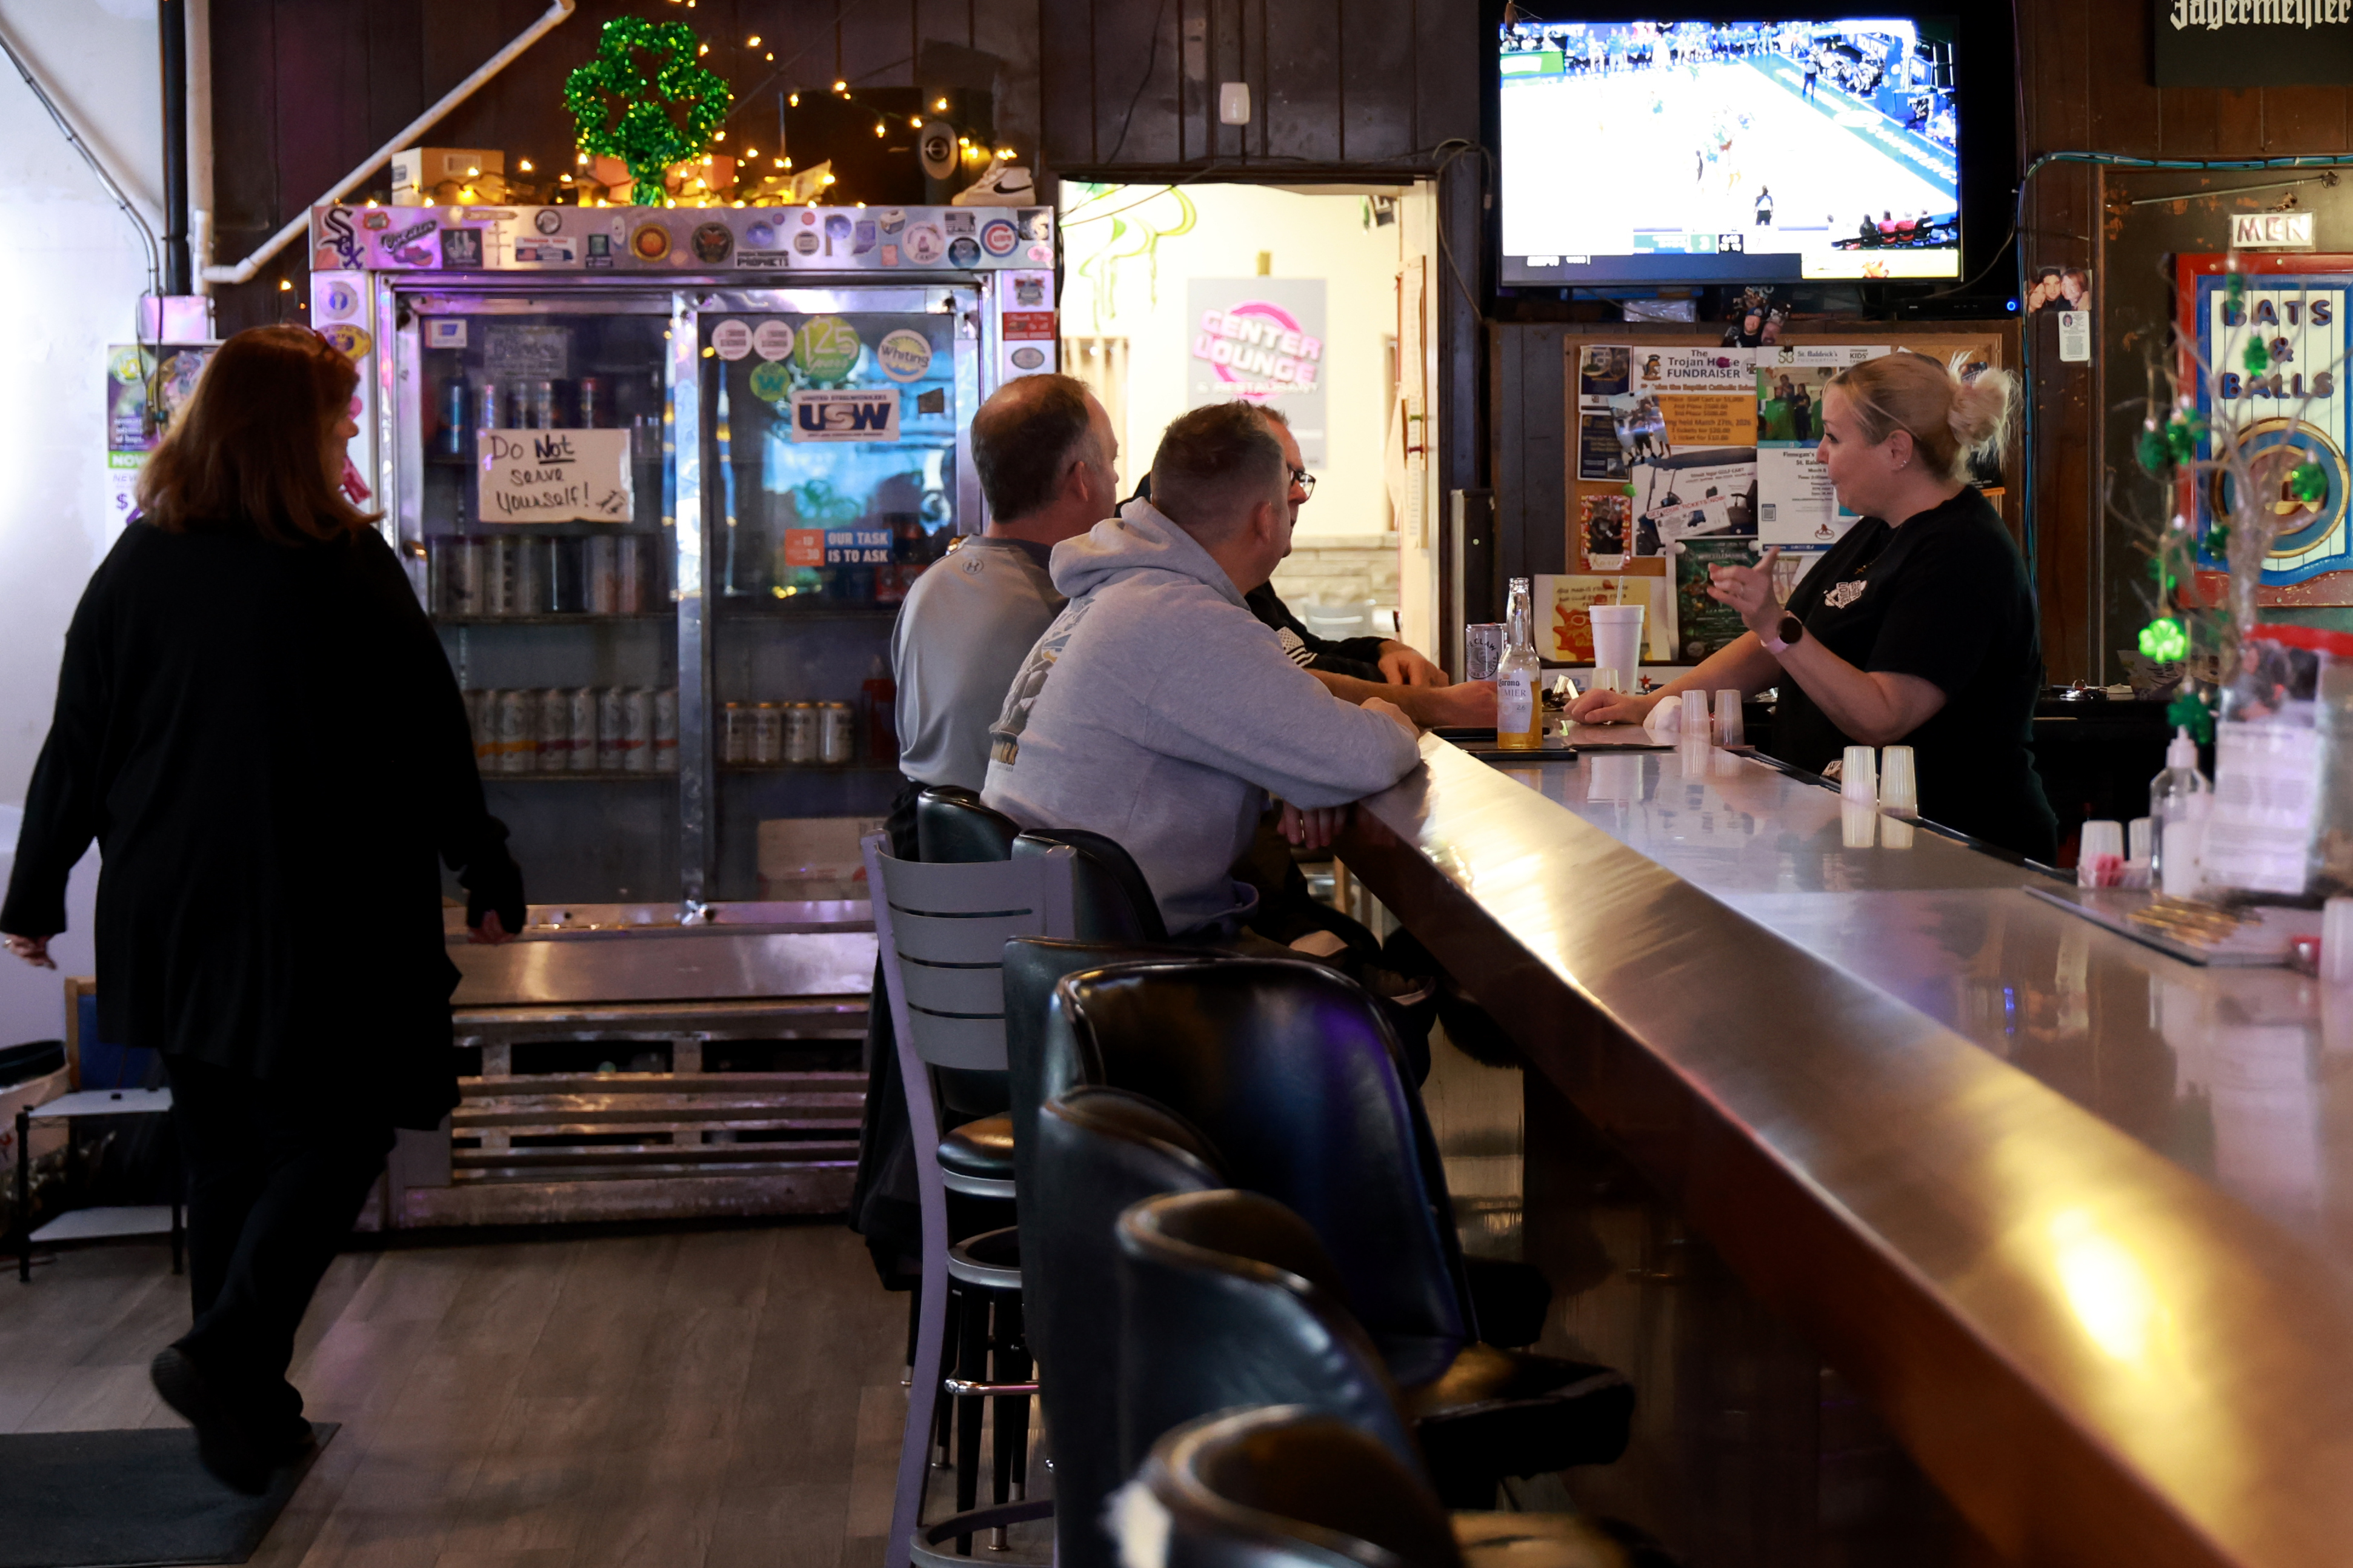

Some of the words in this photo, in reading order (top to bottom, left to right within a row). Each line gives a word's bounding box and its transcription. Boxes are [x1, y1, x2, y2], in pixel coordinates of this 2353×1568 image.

[2237, 216, 2308, 242] MEN
[2222, 299, 2332, 326] BATS
[801, 317, 859, 362] 125
[1201, 309, 1322, 362] CENTER
[881, 344, 929, 367] Whiting
[1193, 335, 1317, 385] LOUNGE
[2269, 337, 2294, 362] &
[1667, 369, 1740, 378] FUNDRAISER
[1668, 357, 1703, 368] Trojan
[2222, 372, 2334, 399] BALLS
[798, 403, 891, 431] USW
[491, 435, 524, 460] Do
[534, 433, 574, 459] Not
[116, 493, 128, 510] $
[828, 531, 853, 545] OUR
[857, 531, 888, 545] TASK
[827, 549, 841, 562] IS
[844, 549, 860, 563] TO
[862, 550, 888, 563] ASK
[1474, 638, 1496, 651] CLAW
[1498, 678, 1520, 687] Corona
